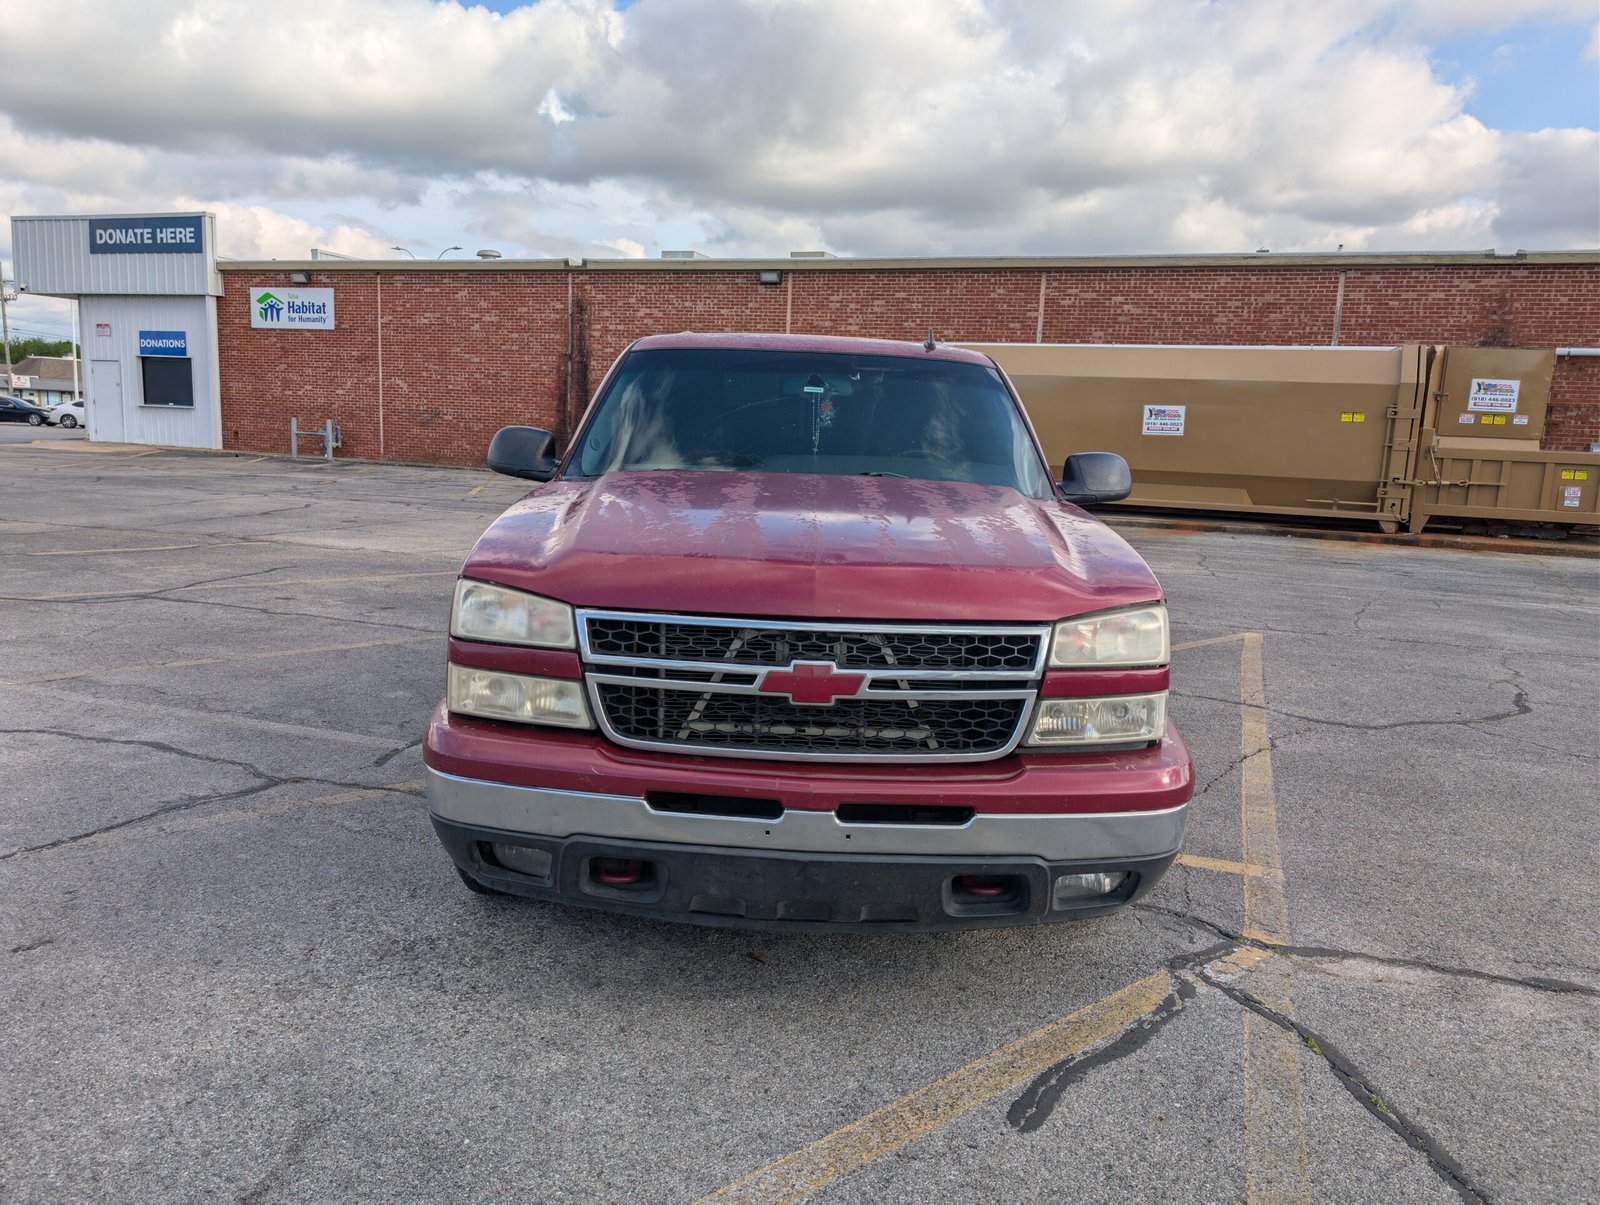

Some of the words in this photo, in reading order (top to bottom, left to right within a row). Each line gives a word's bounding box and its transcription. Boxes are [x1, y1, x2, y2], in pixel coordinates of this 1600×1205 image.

[96, 228, 153, 245] DONATE
[156, 227, 196, 244] HERE
[288, 301, 326, 314] Habitat
[298, 316, 326, 324] Humanity
[140, 339, 186, 348] DONATIONS
